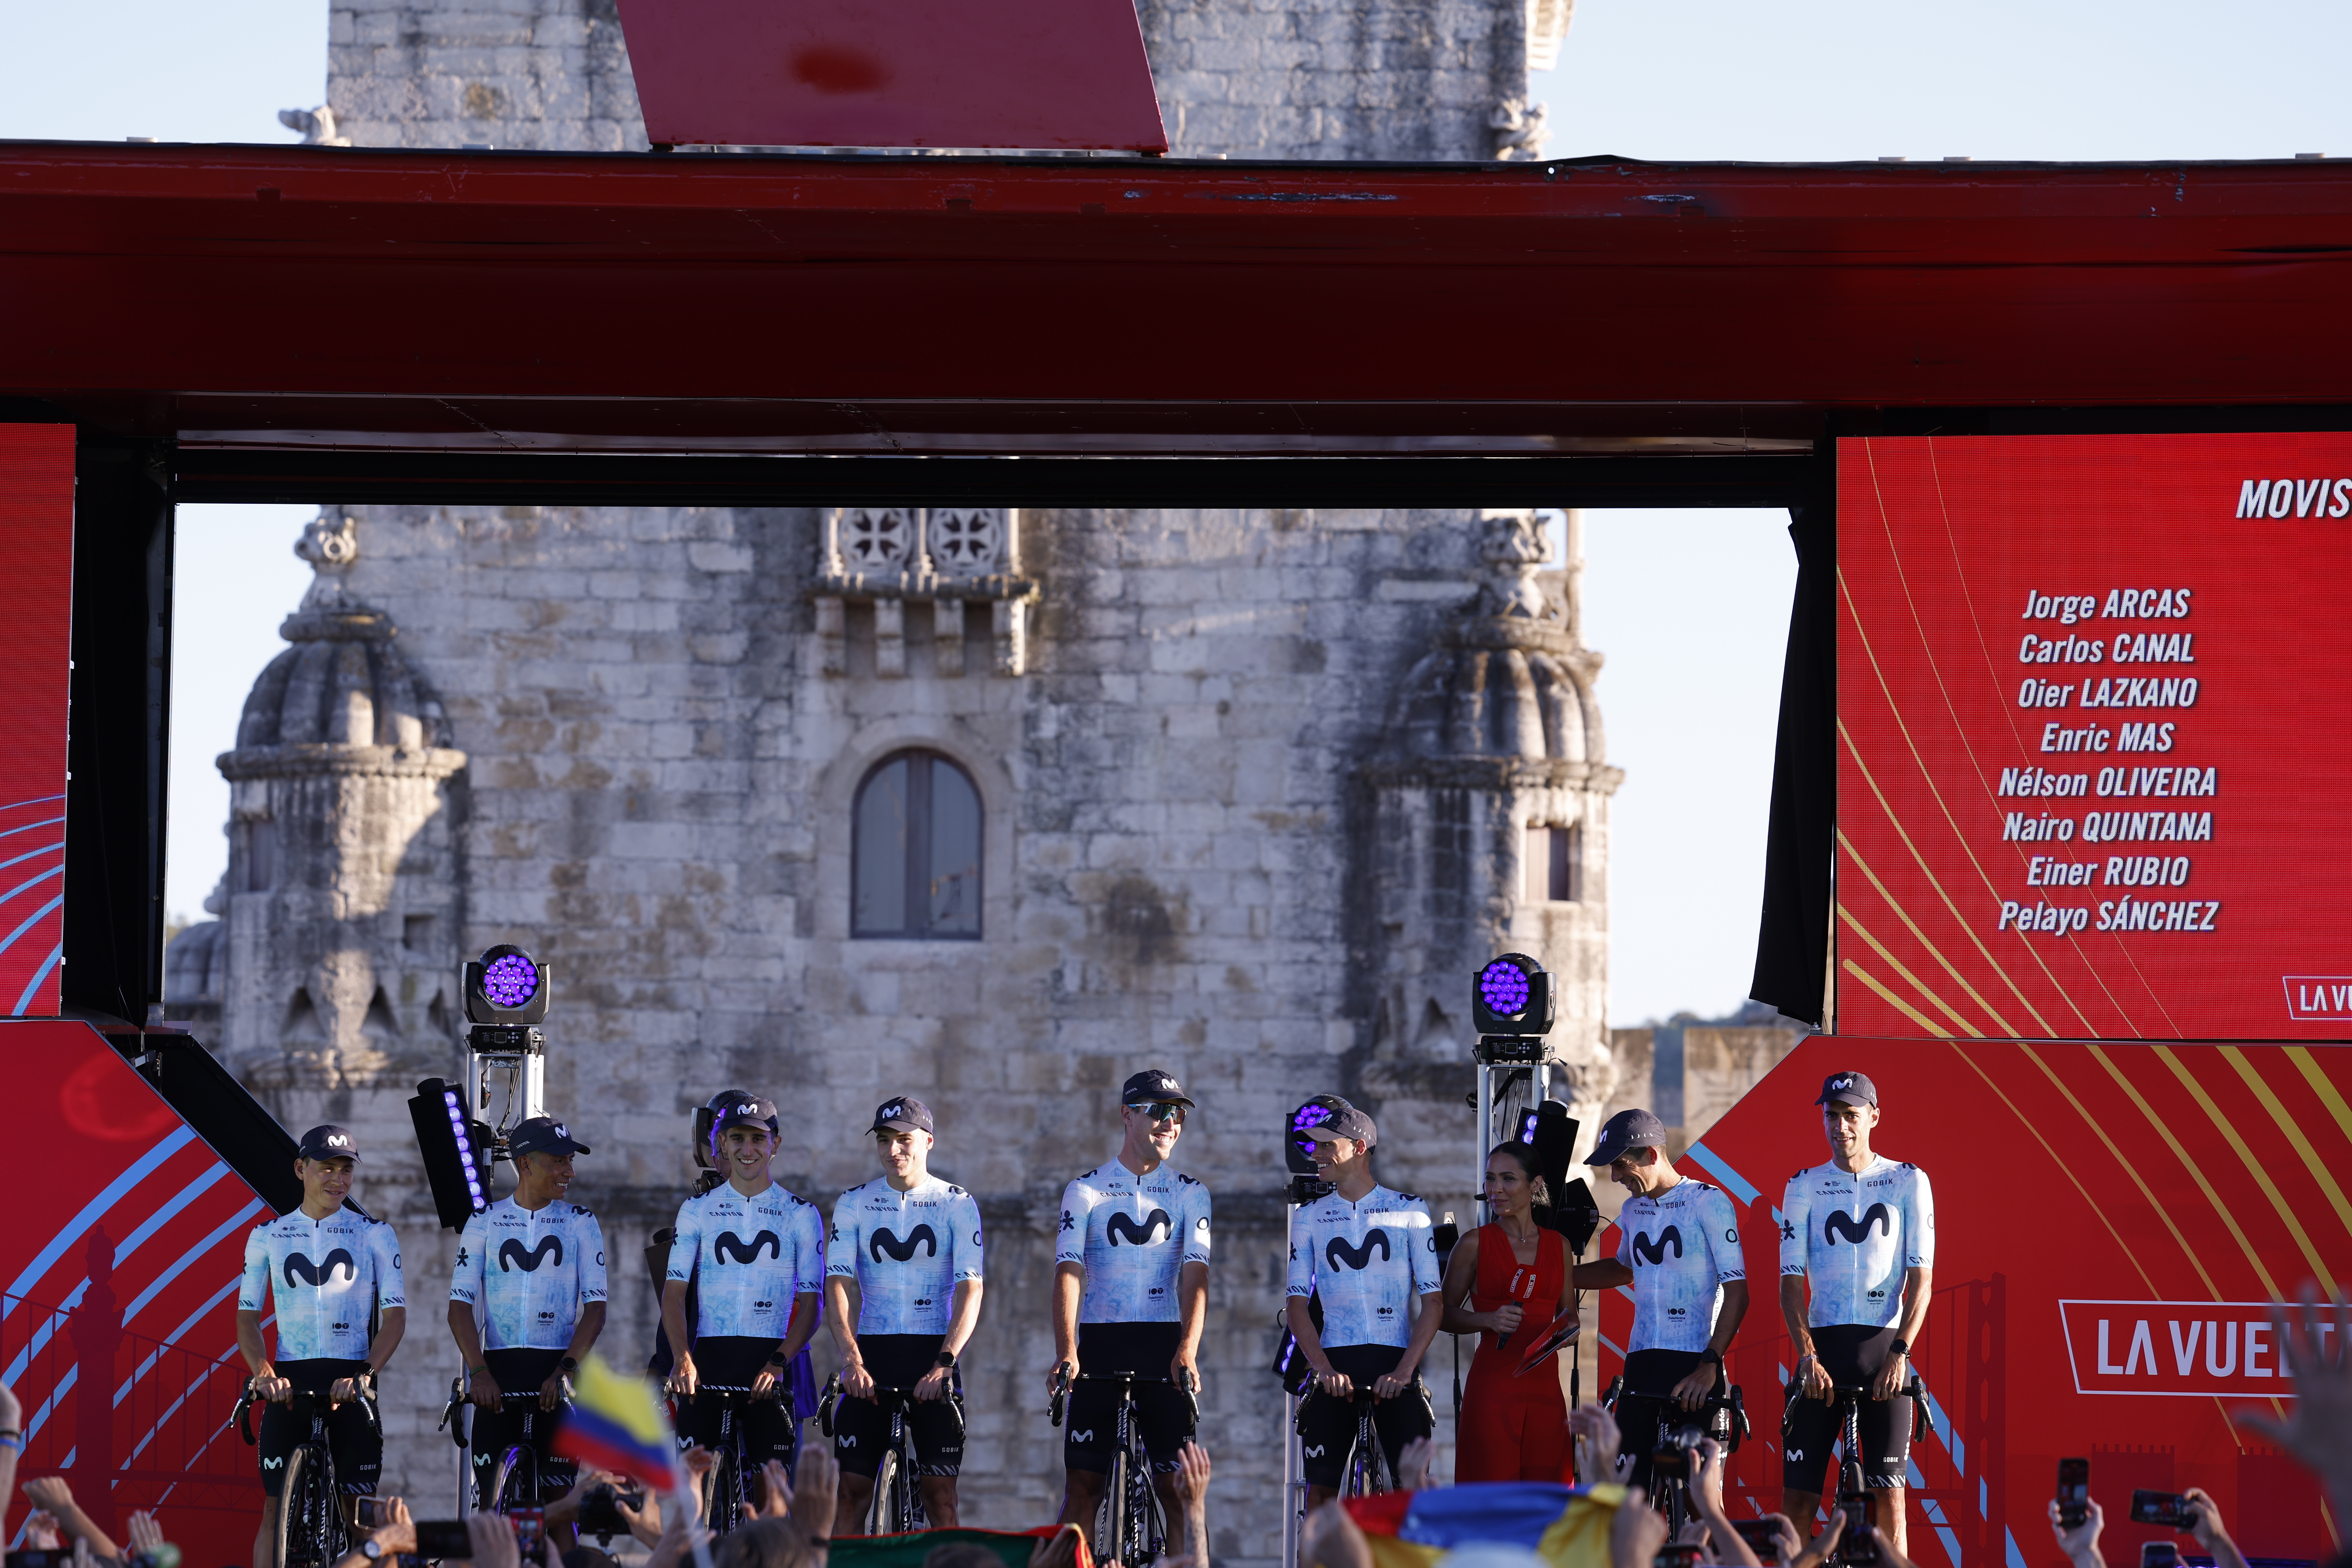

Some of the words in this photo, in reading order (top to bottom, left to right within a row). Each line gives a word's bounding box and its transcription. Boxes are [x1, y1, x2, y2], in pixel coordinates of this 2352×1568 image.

[2236, 478, 2352, 518] MOVIS
[2023, 589, 2096, 624] Jorge
[2102, 588, 2190, 618] ARCAS
[2019, 634, 2103, 662] Carlos
[2112, 633, 2194, 662] CANAL
[2018, 678, 2074, 707] Oier
[2080, 677, 2198, 707] LAZKANO
[2041, 723, 2110, 751] Enric
[2118, 722, 2175, 751] MAS
[1998, 766, 2088, 796] Nélson
[2096, 767, 2216, 796] OLIVEIRA
[2003, 812, 2074, 841] Nairo
[2082, 811, 2212, 842] QUINTANA
[2027, 856, 2098, 886] Einer
[2104, 856, 2189, 886] RUBIO
[1998, 900, 2088, 936] Pelayo
[2096, 894, 2219, 931] SÁNCHEZ
[2300, 985, 2328, 1011] LA
[516, 1140, 530, 1149] CANYON
[1867, 1178, 1893, 1187] GOBIK
[758, 1207, 782, 1216] GOBIK
[1666, 1201, 1686, 1209] GOBIK
[450, 1289, 475, 1300] YON
[581, 1289, 607, 1298] CAN
[1286, 1285, 1308, 1295] YON
[2098, 1319, 2158, 1375] LA
